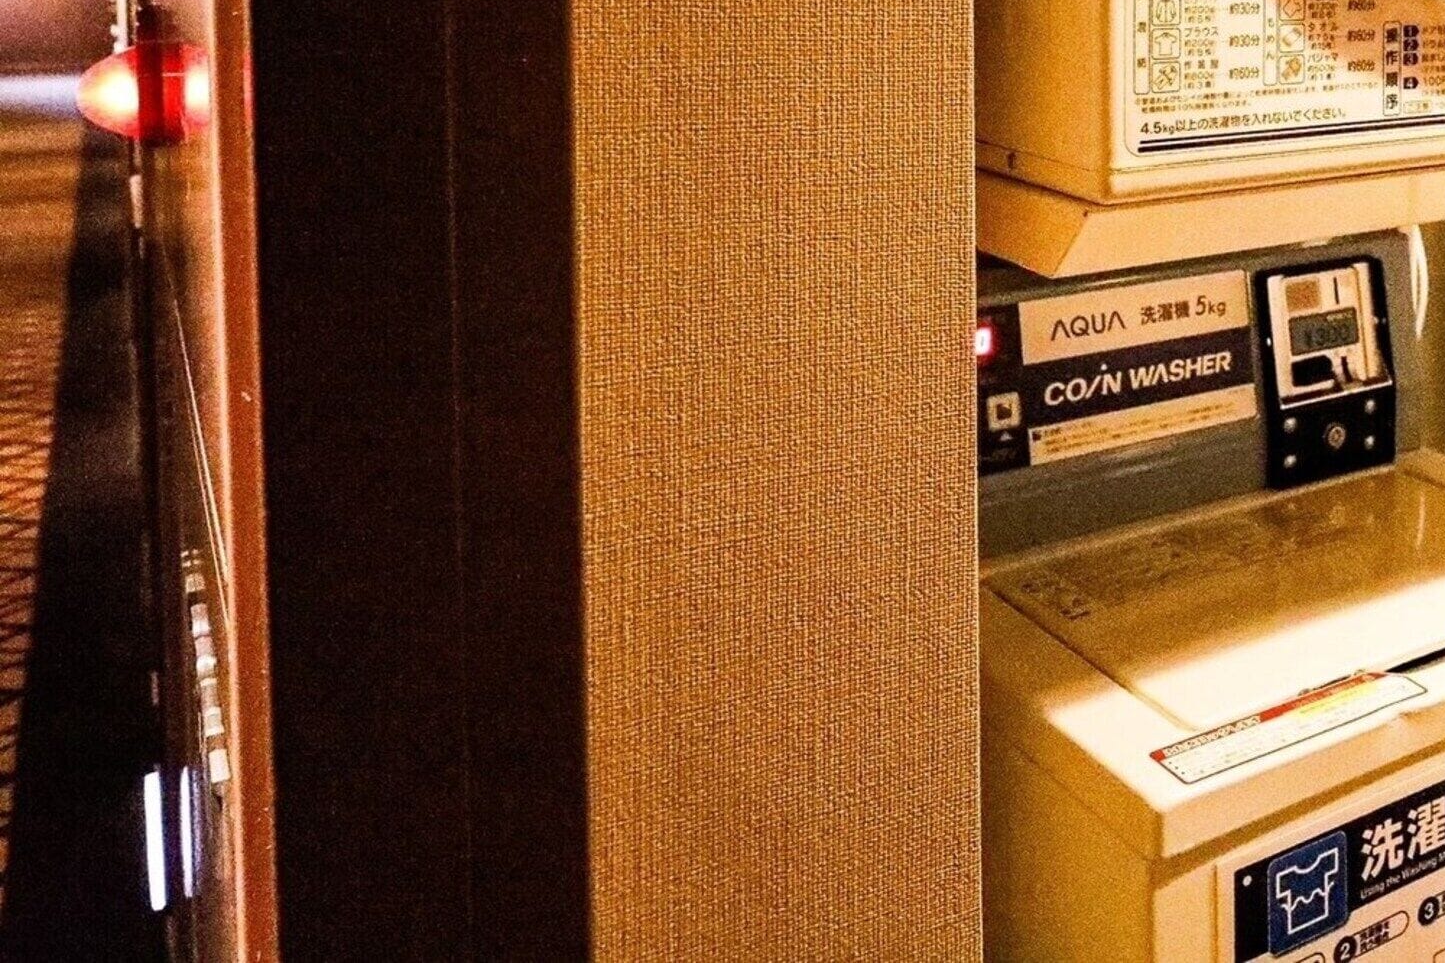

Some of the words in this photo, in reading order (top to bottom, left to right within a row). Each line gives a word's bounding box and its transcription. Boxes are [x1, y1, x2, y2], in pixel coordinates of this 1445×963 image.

[1050, 310, 1126, 341] AQUA
[1139, 301, 1191, 325] 洗濯機
[1194, 295, 1227, 318] 5kg
[1129, 350, 1233, 392] WASHER
[1360, 882, 1385, 899] Using
[1401, 857, 1438, 879] Washing
